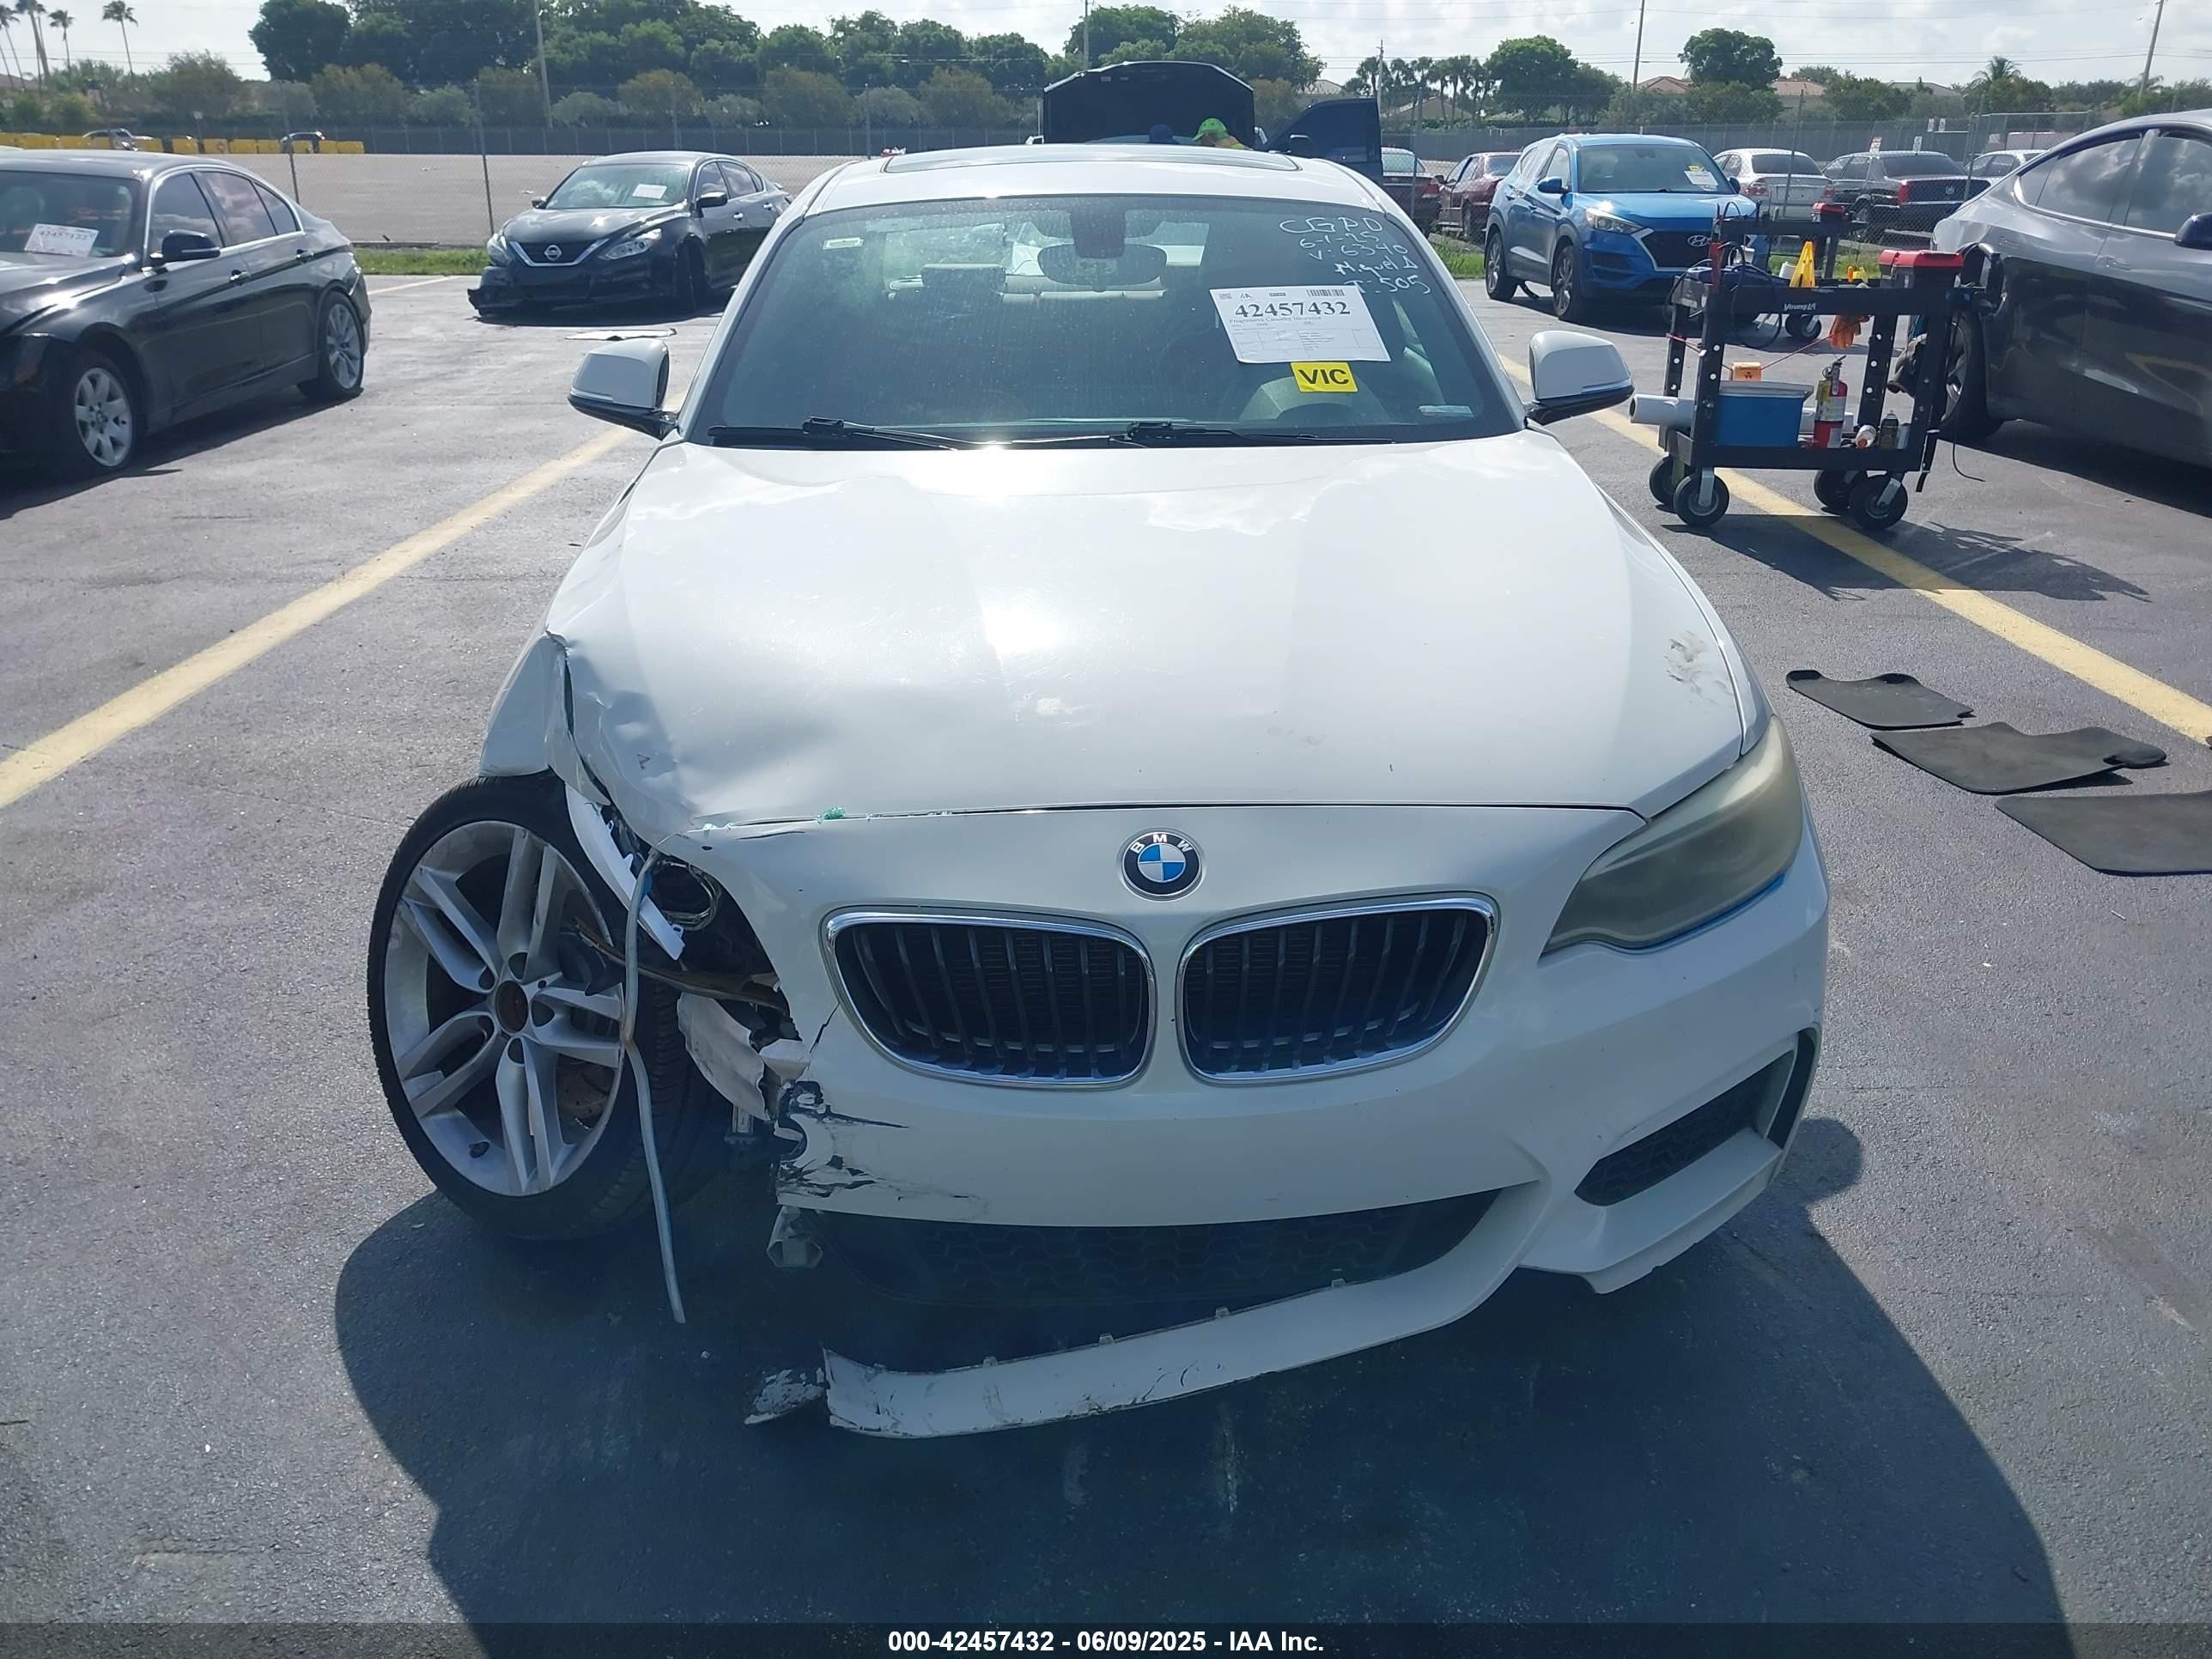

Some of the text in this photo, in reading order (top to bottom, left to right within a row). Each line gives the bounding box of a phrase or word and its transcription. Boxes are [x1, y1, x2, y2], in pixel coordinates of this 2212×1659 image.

[1299, 231, 1379, 249] 6-1-25
[1235, 301, 1351, 318] 42457432
[1297, 368, 1350, 385] VIC
[1129, 834, 1194, 854] BMW
